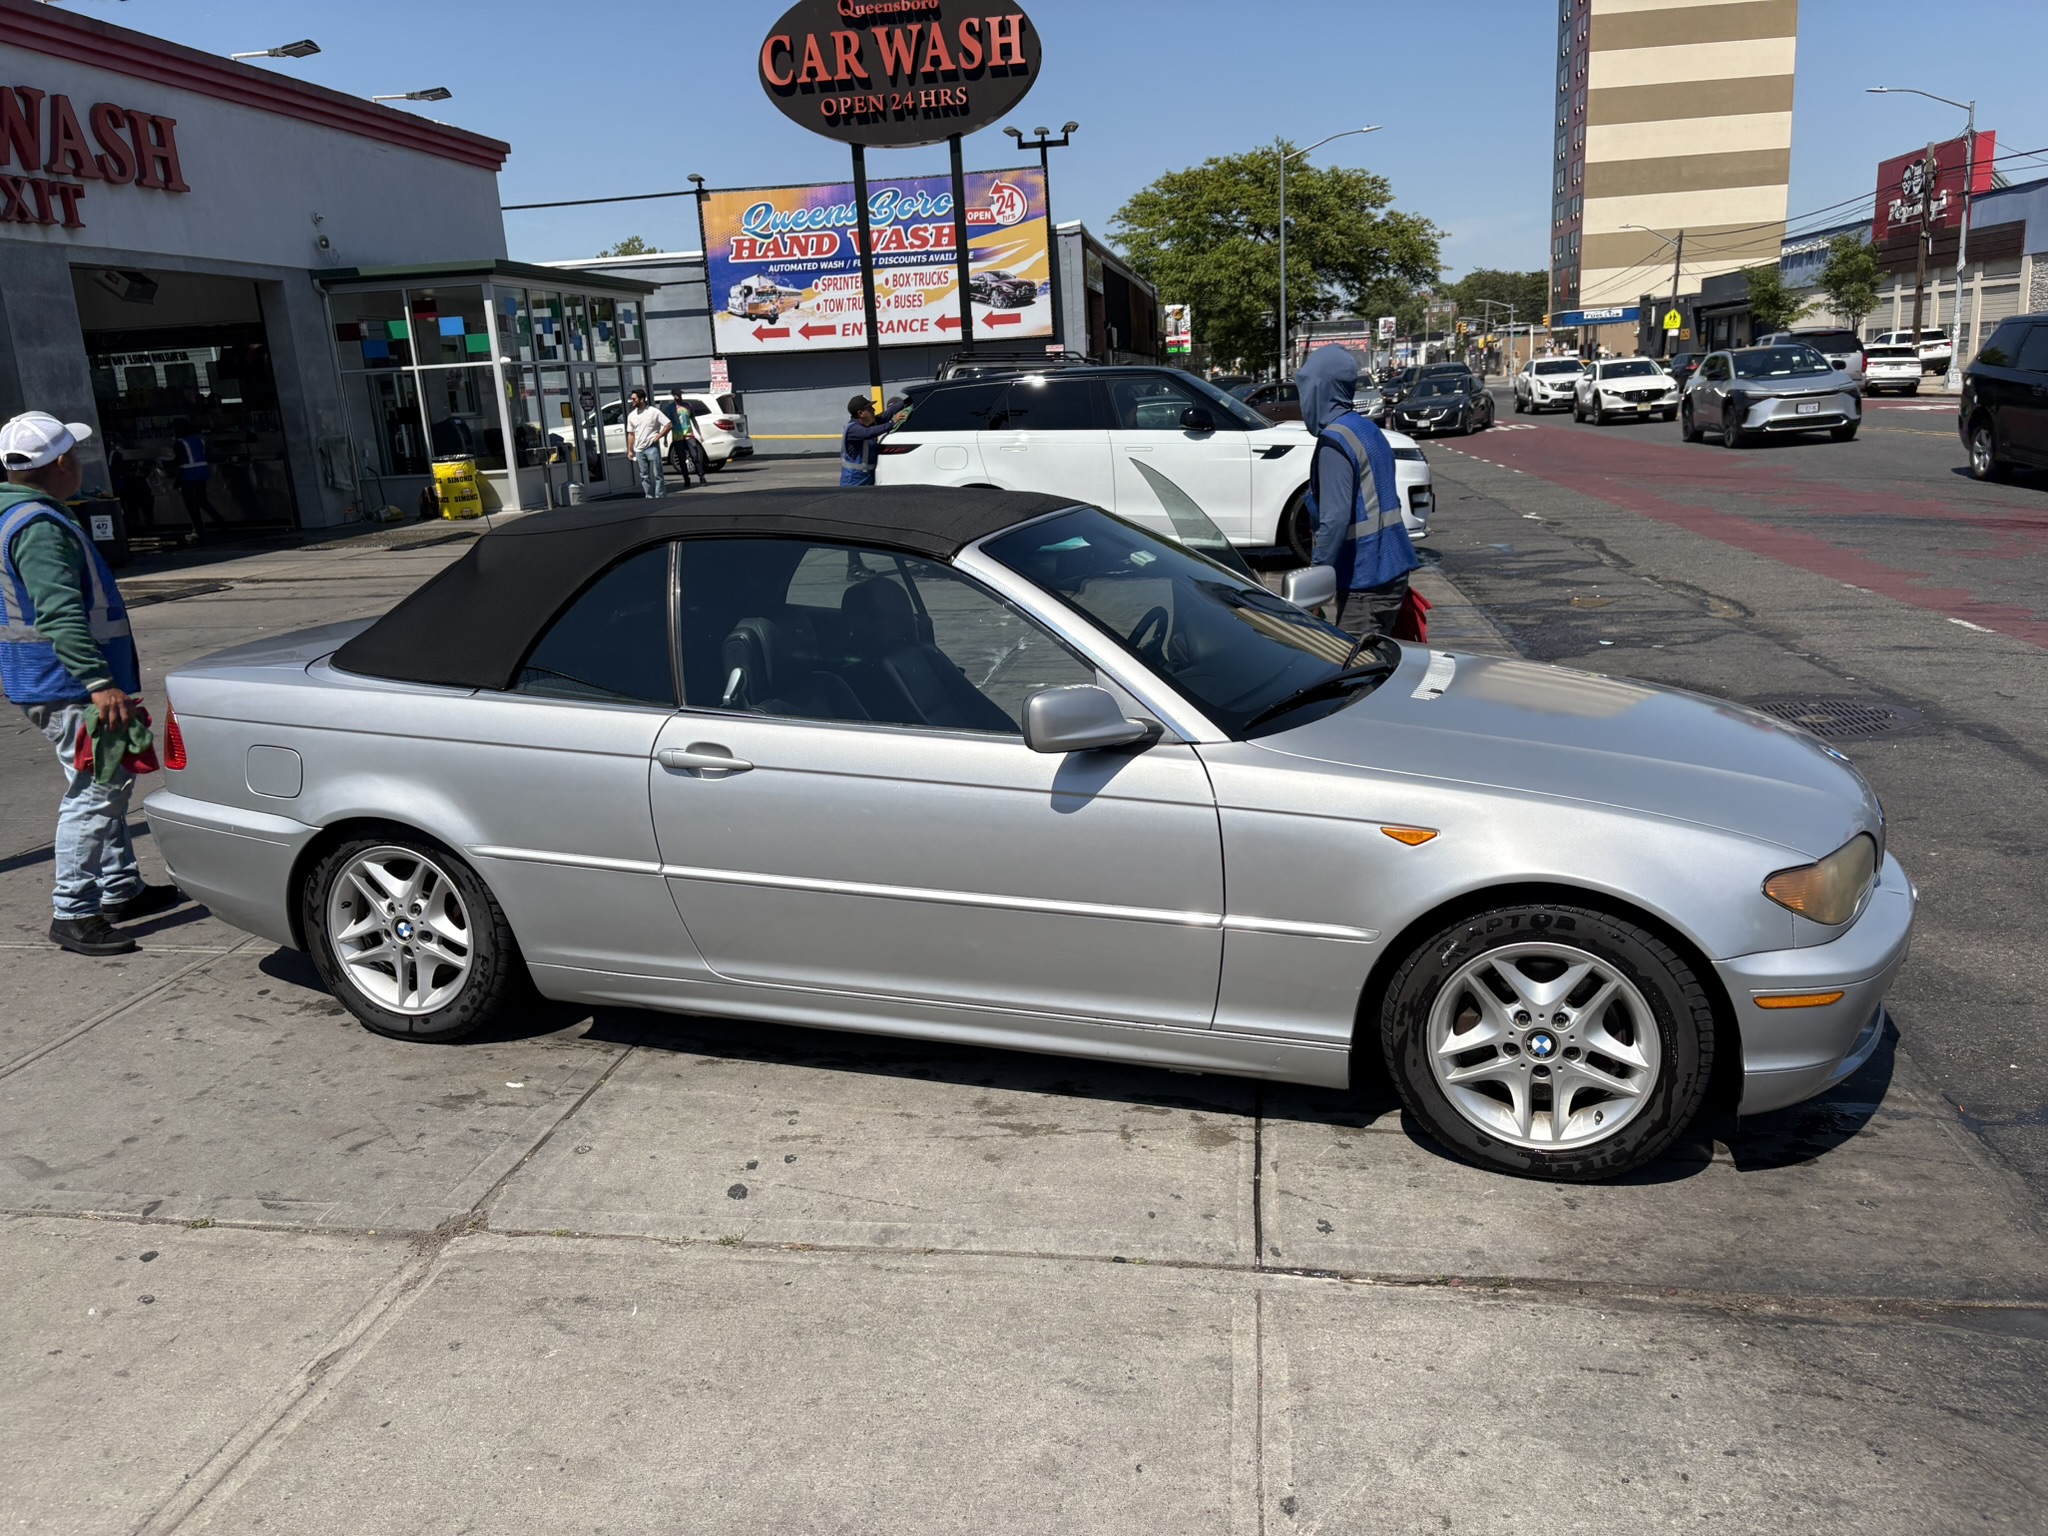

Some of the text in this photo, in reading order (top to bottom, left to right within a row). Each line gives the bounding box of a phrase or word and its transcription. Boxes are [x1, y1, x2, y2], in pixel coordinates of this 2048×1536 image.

[761, 14, 1026, 87] CAR WASH
[820, 86, 968, 117] OPEN 24 HRS
[0, 173, 87, 229] XIT
[995, 191, 1016, 217] 24
[967, 211, 1017, 224] OPEN hrs
[729, 231, 840, 262] HAND
[768, 262, 818, 273] AUTOMATED
[820, 260, 844, 270] WASH
[853, 257, 877, 268] FLT
[879, 254, 927, 265] DISCOUNTS
[928, 251, 974, 262] AVAILAE
[893, 273, 911, 288] BOX
[913, 270, 949, 287] TRUCKS
[823, 294, 923, 313] TOW TRUS BUSES
[841, 318, 929, 337] ENRANCE
[447, 475, 473, 484] SIMONIZ
[454, 494, 479, 503] SIMONIZ
